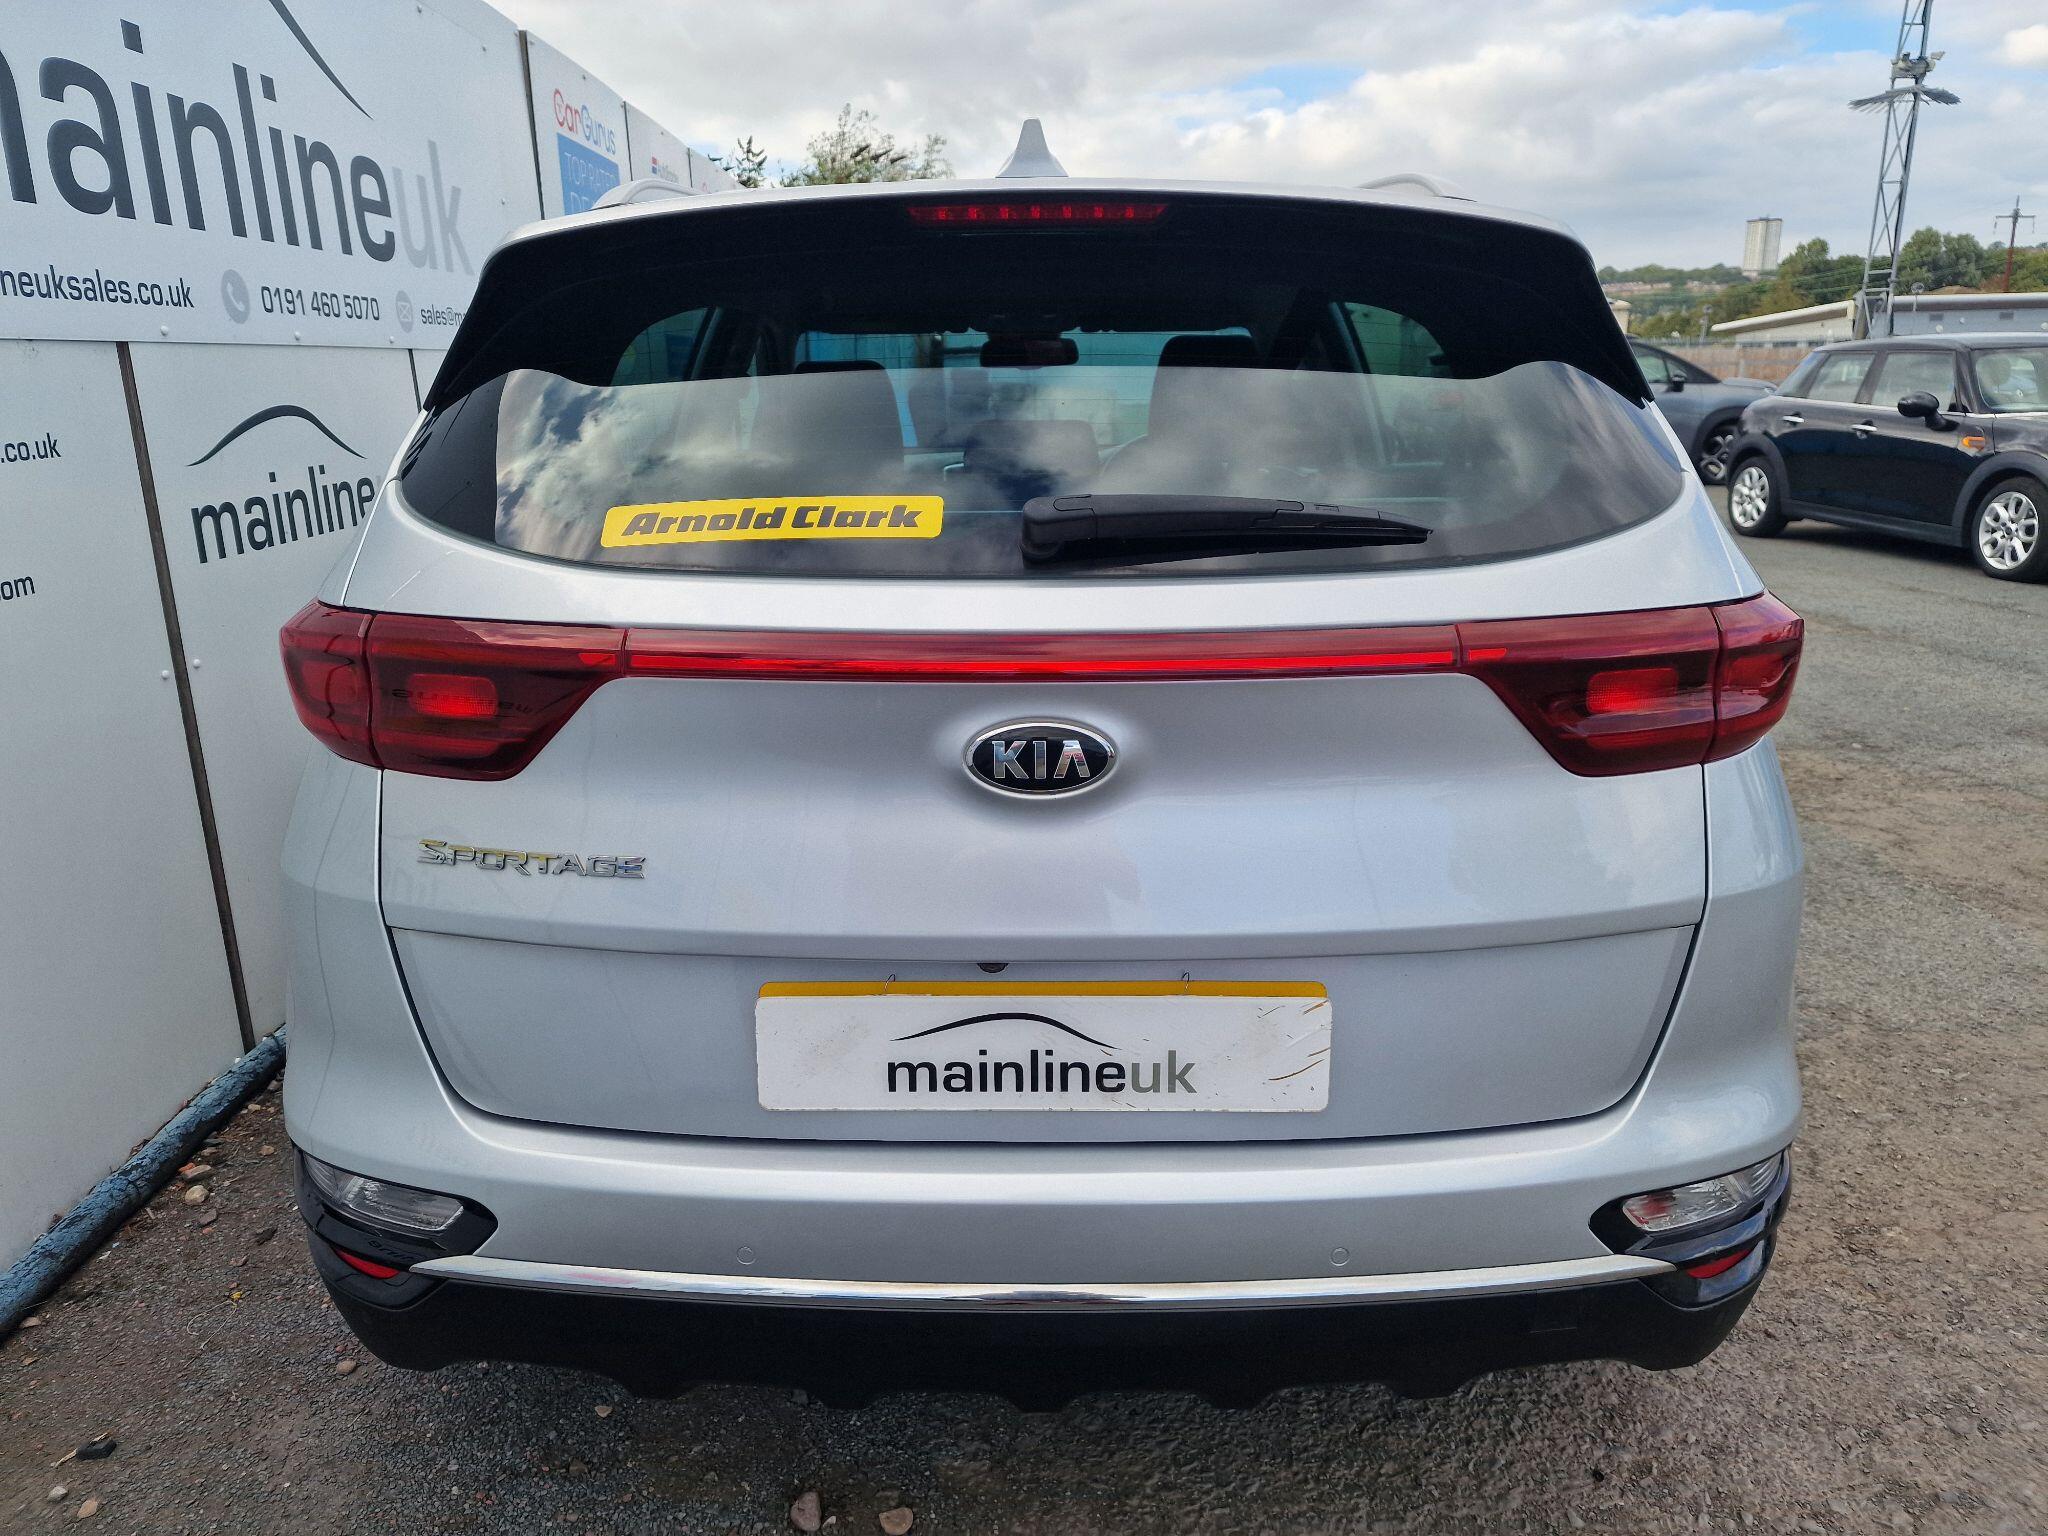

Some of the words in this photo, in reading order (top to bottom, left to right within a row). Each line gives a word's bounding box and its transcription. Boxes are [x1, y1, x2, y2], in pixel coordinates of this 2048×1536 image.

[553, 88, 616, 155] CarGurus
[261, 286, 305, 315] 0191
[311, 291, 341, 318] 460
[343, 294, 380, 320] 5070
[621, 506, 787, 537] Arnold
[791, 504, 925, 529] Clark
[0, 575, 36, 600] om
[991, 740, 1091, 779] KIA
[416, 838, 648, 879] SPORTAGE
[887, 1049, 1198, 1094] mainlineuk
